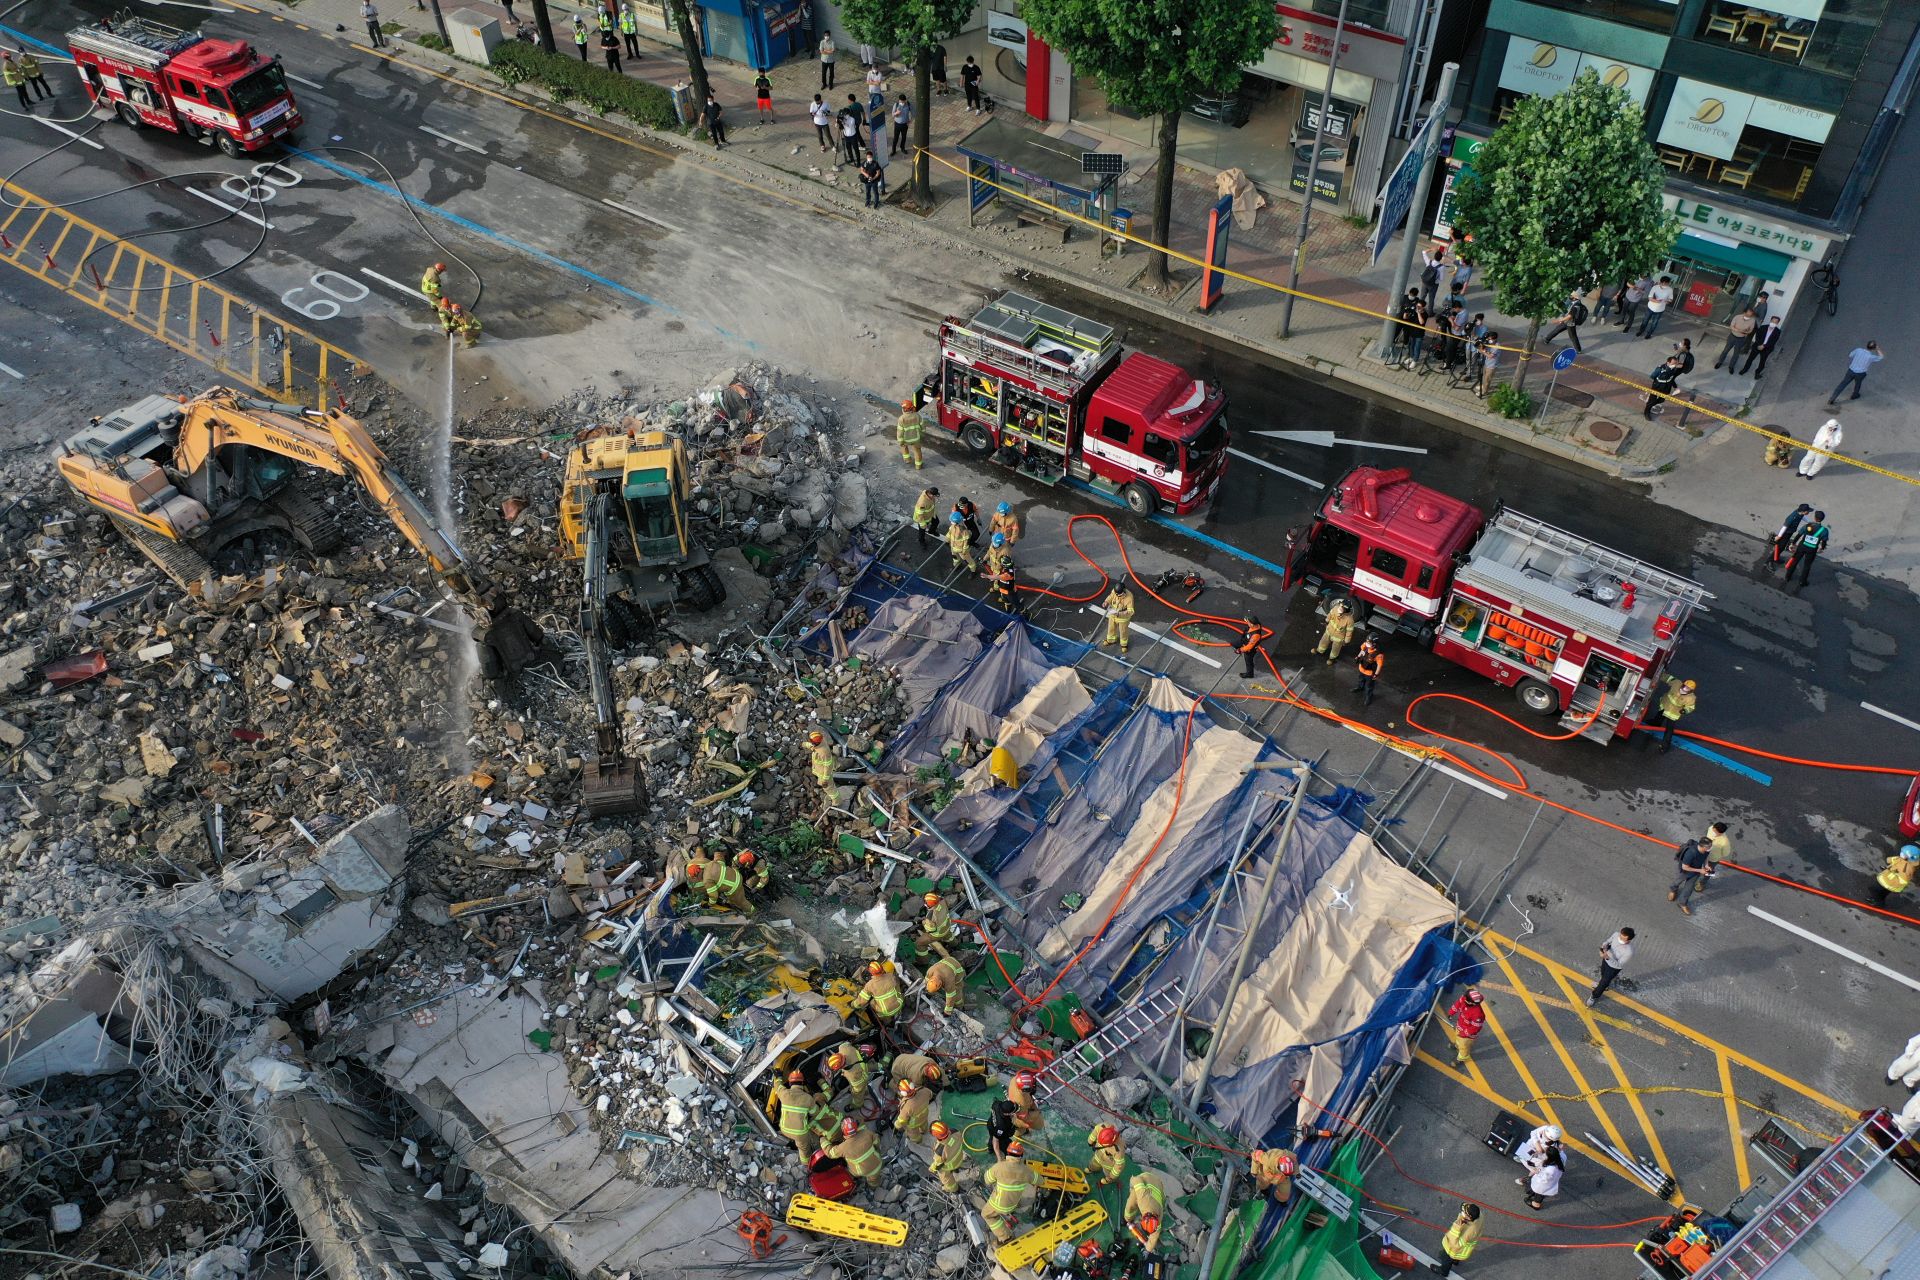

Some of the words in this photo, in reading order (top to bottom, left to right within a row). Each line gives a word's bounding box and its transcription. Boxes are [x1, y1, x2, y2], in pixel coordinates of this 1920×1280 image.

[221, 162, 303, 203] 60
[1716, 215, 1814, 252] 여성크로커다일
[281, 270, 370, 321] 60
[265, 433, 318, 460] HYUNDAI
